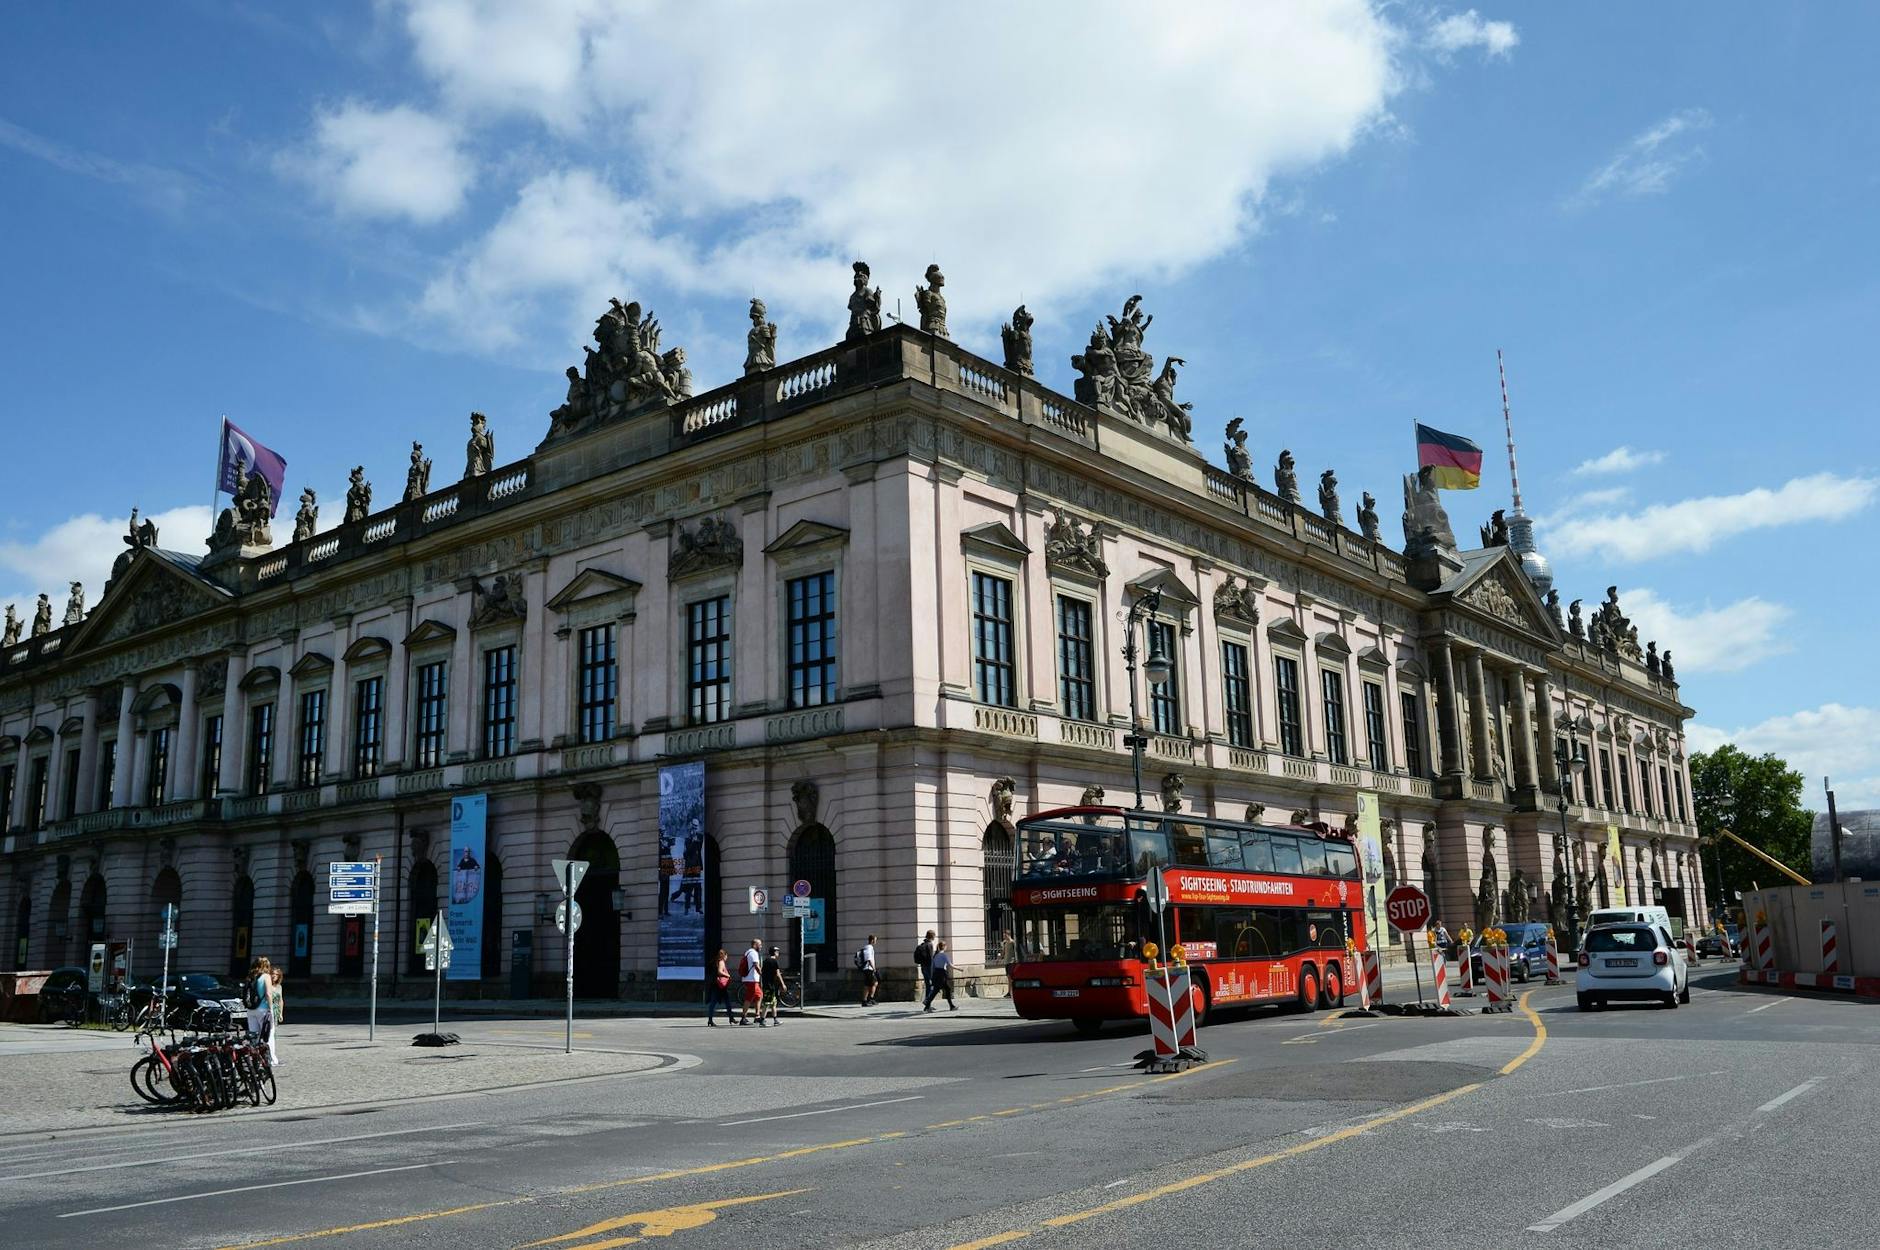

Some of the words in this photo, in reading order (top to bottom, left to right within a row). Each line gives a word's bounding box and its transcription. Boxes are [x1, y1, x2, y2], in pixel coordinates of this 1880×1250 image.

[453, 802, 464, 821] D
[1042, 887, 1097, 900] SIGHTSEEING
[1180, 876, 1227, 893] SIGHTSEEING
[1230, 879, 1294, 895] STADTRUNDFAHRTEN
[1389, 898, 1426, 920] STOP
